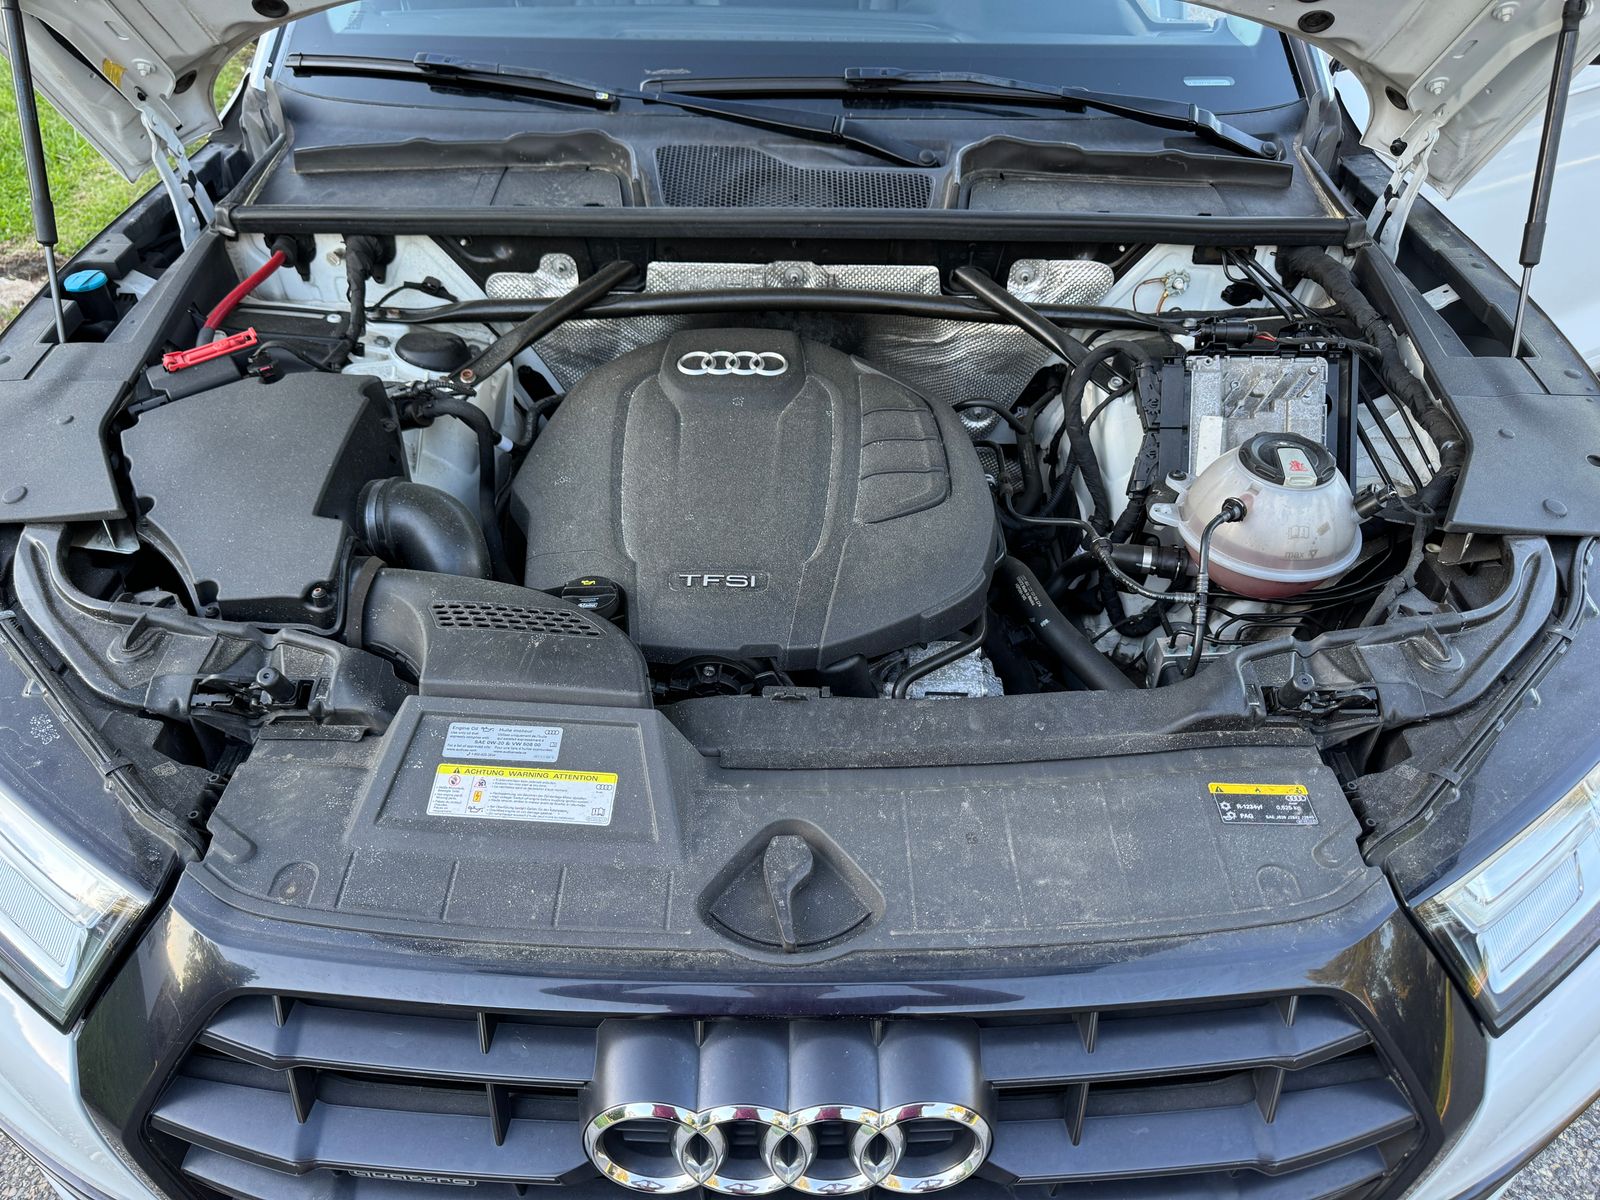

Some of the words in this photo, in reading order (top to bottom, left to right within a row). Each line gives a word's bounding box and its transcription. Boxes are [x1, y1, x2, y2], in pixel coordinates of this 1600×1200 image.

[679, 574, 756, 587] TFSI
[464, 768, 504, 776] ACHTUNG
[508, 770, 549, 779] WARNING
[553, 772, 599, 782] ATTENTION
